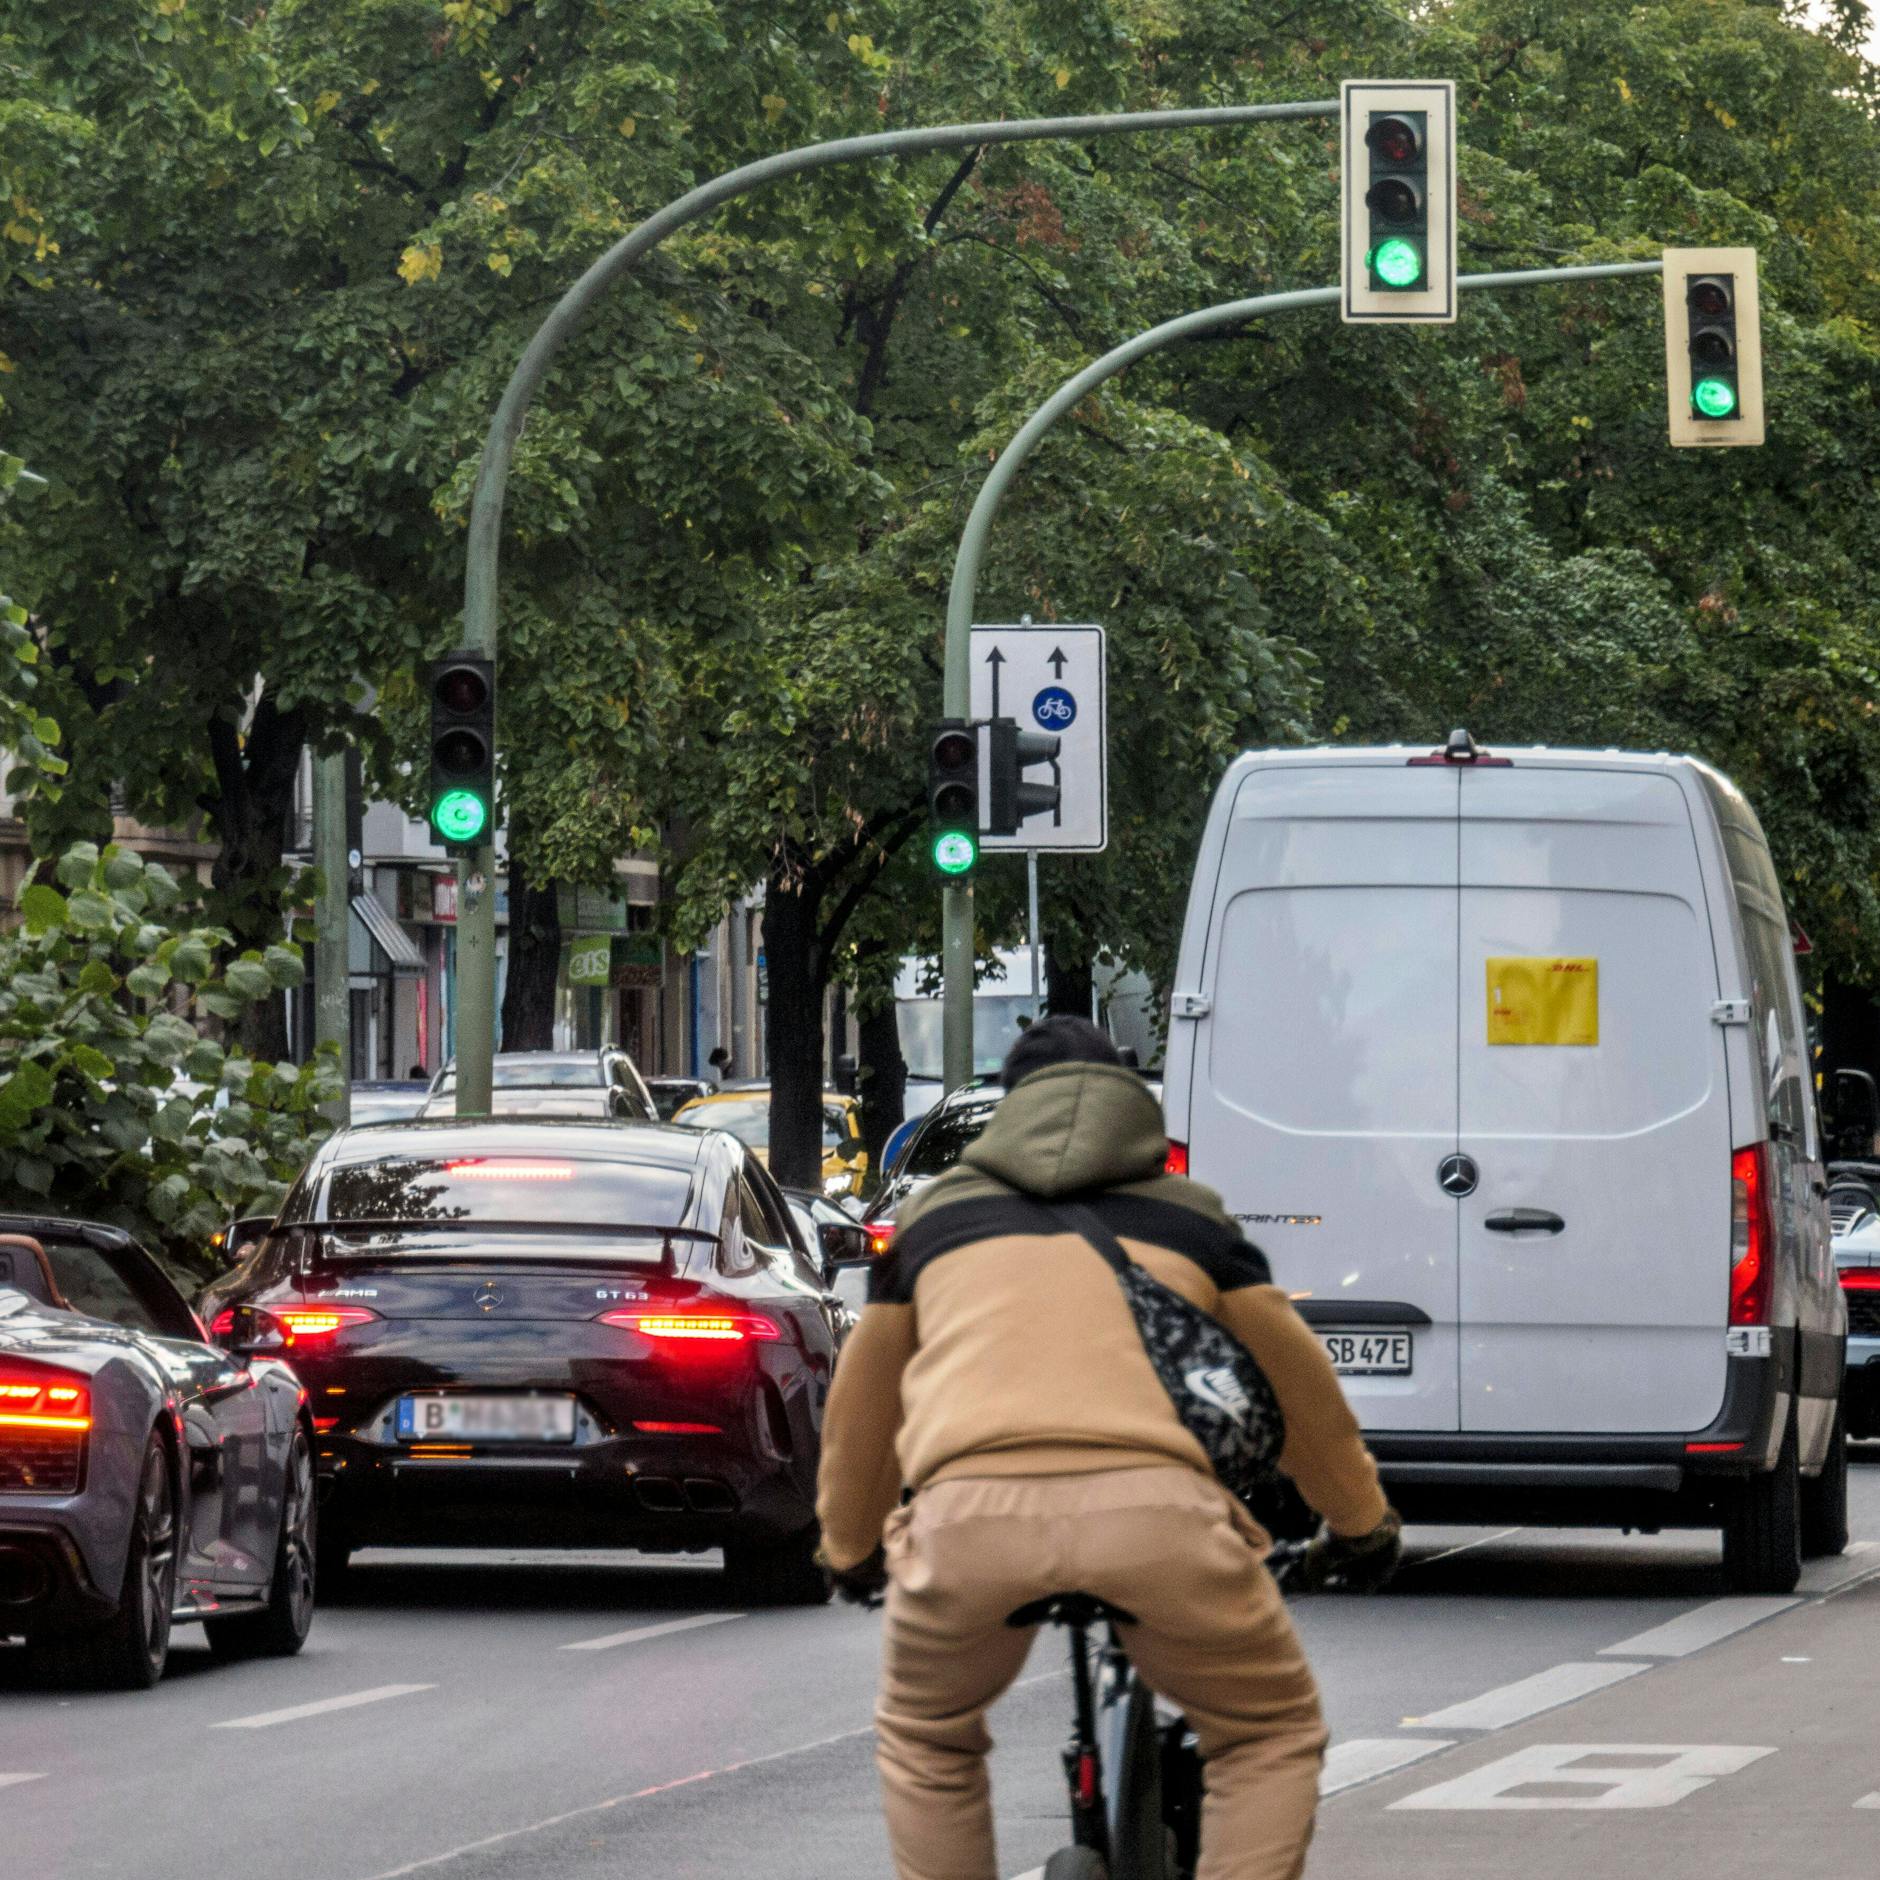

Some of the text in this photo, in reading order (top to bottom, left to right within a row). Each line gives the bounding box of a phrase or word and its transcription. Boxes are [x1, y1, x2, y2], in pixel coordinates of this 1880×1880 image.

[1233, 1213, 1322, 1225] PRINTER
[596, 1290, 649, 1301] GT 63
[1325, 1337, 1407, 1364] SB 47E
[1204, 1367, 1251, 1411] NIKE
[425, 1402, 444, 1429] B
[1383, 1743, 1880, 1810] B
